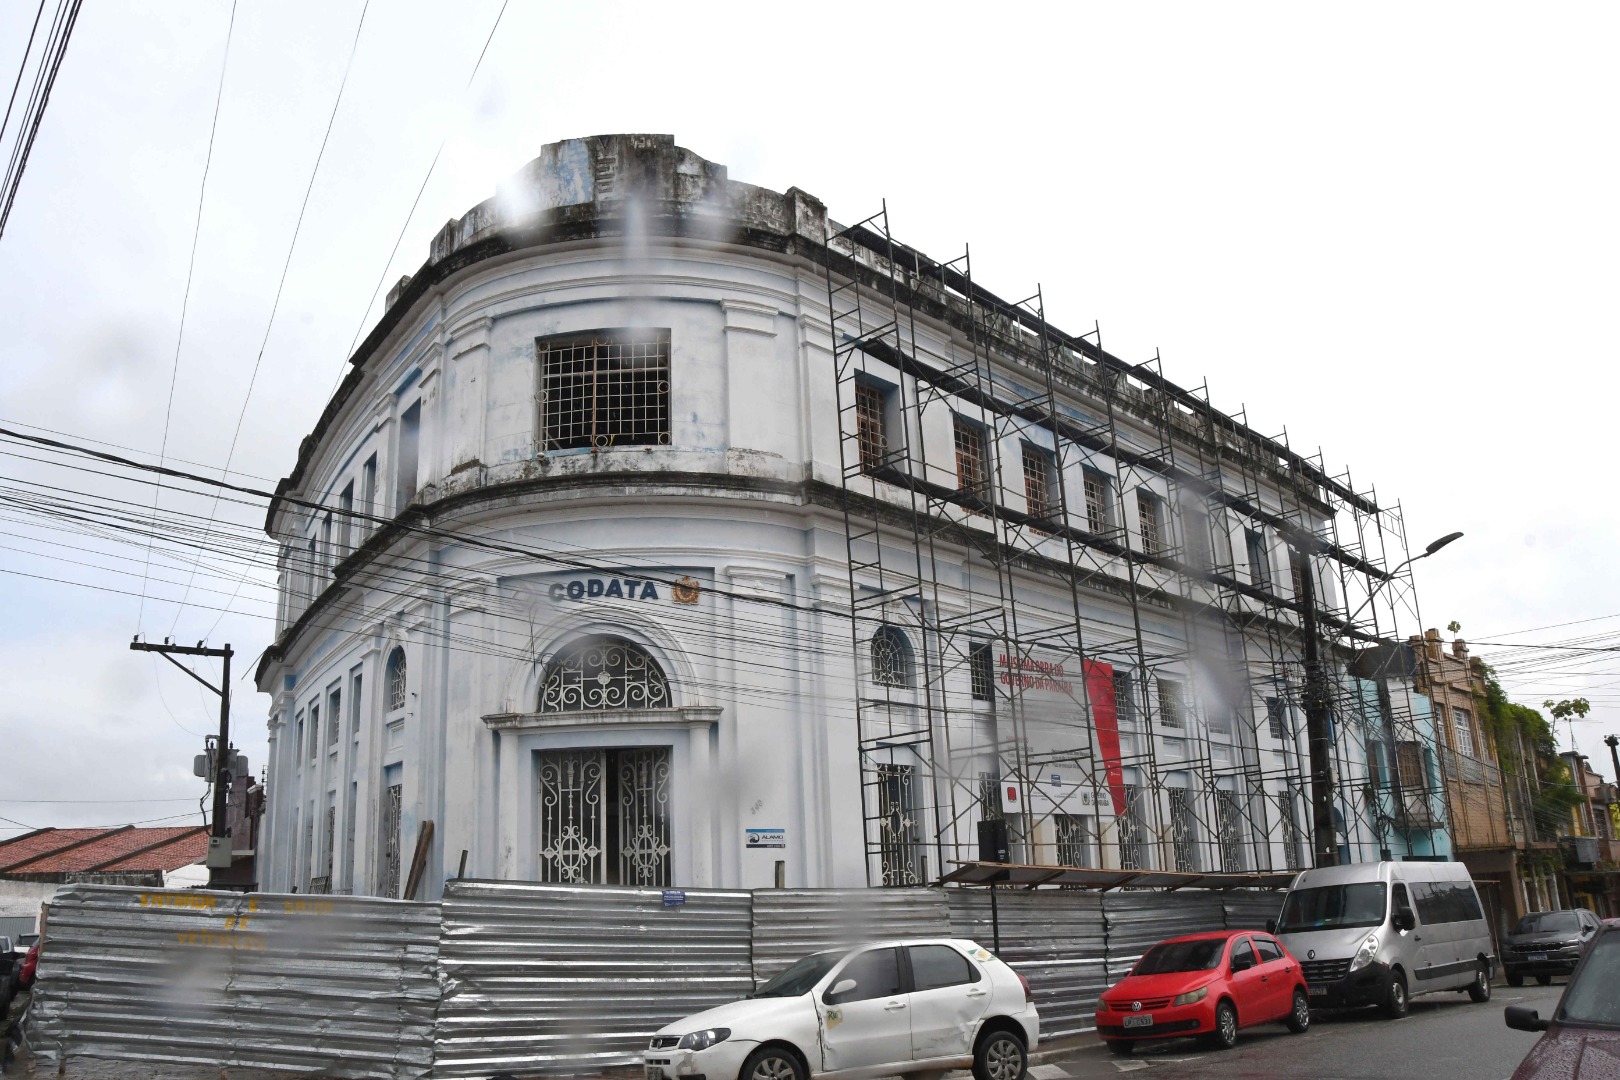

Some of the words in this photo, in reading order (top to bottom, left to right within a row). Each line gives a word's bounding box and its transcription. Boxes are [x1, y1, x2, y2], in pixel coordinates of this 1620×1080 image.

[550, 578, 659, 601] CODATA
[141, 893, 216, 910] ENTRADA
[224, 914, 251, 929] DE
